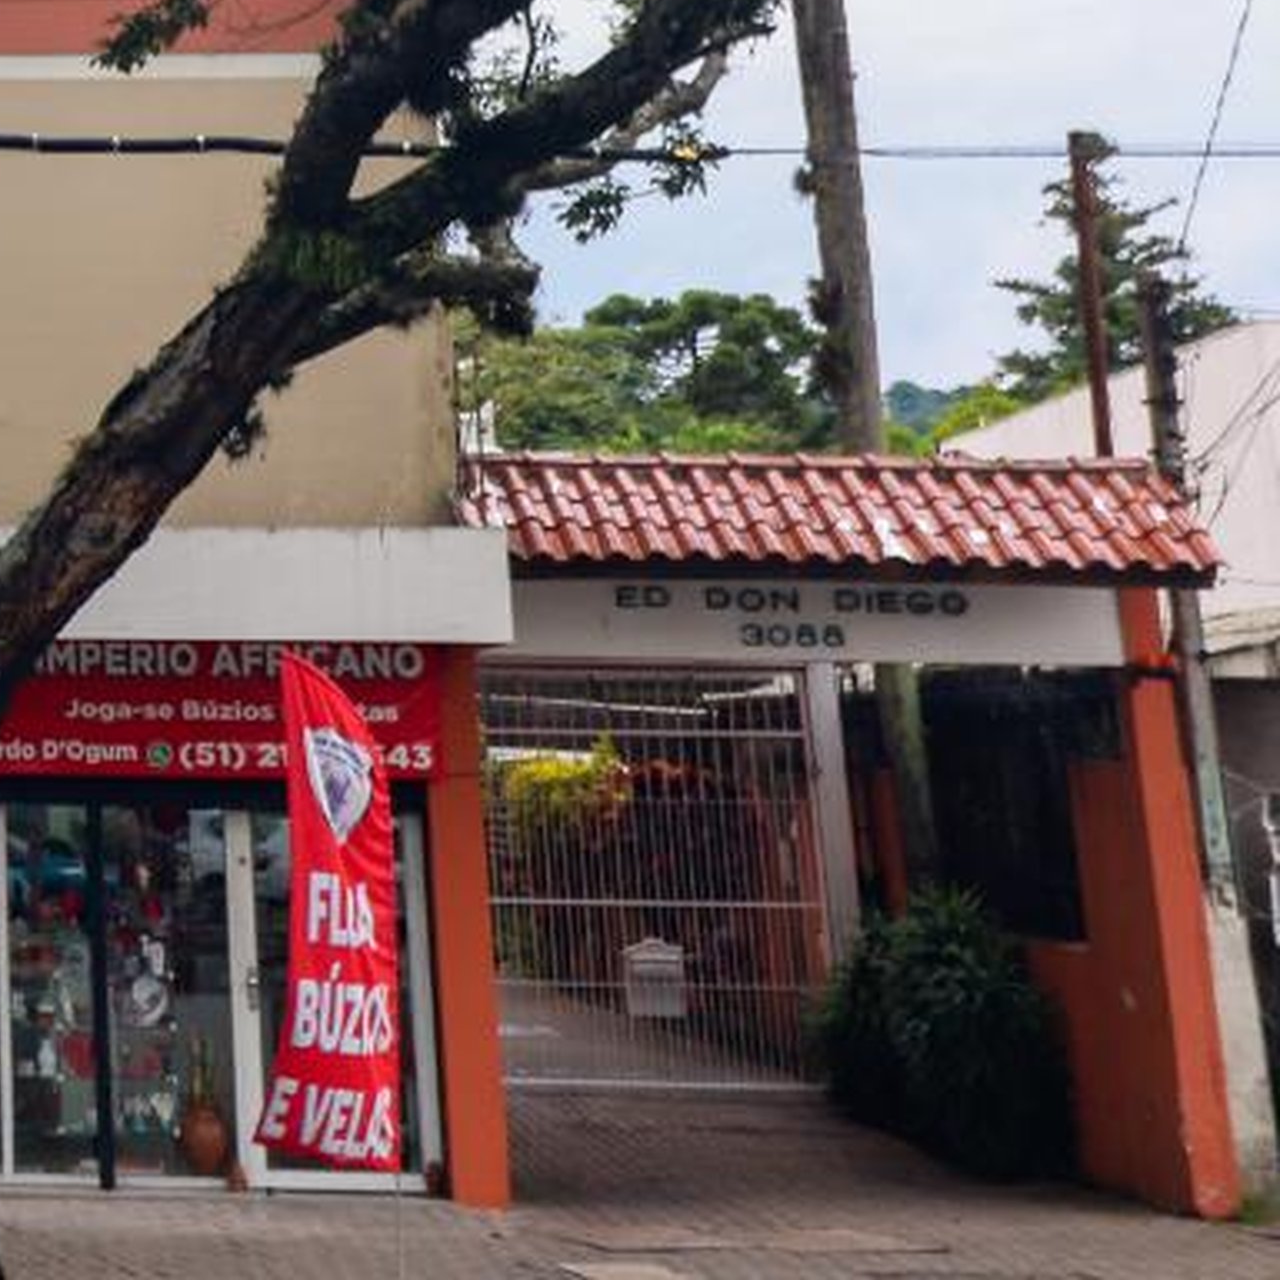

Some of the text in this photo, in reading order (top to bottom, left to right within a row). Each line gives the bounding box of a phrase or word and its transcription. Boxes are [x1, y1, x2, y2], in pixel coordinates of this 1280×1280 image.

[614, 585, 969, 616] ED DON DIEGO
[740, 624, 845, 648] 3088
[63, 698, 174, 723] Joga-se
[181, 698, 275, 722] Búzios
[41, 739, 139, 764] D'Ogum
[180, 741, 246, 771] (51)
[260, 1075, 300, 1141] E
